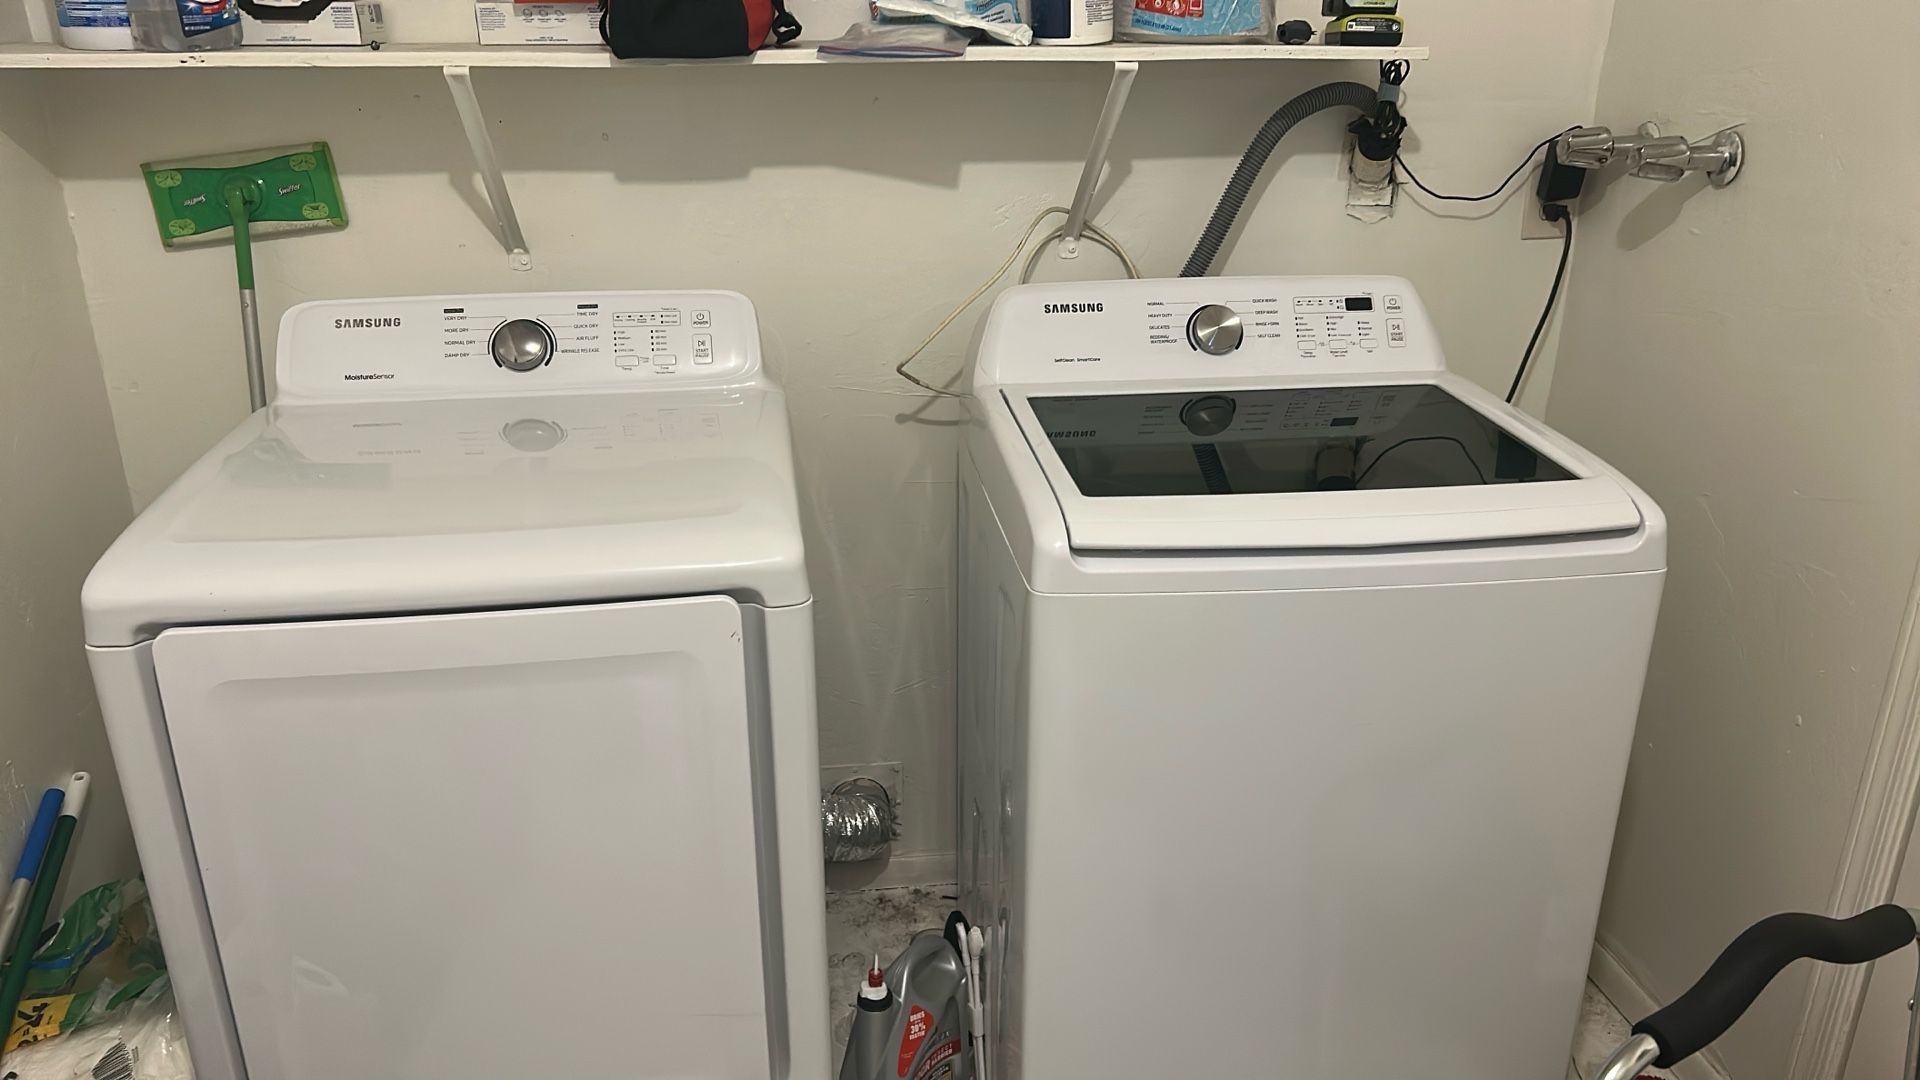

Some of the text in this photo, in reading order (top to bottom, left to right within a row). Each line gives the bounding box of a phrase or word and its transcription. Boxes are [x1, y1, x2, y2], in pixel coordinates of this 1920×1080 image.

[278, 184, 300, 195] Swiffer
[1044, 303, 1104, 314] SAMSUNG
[334, 318, 401, 329] SAMSUNG
